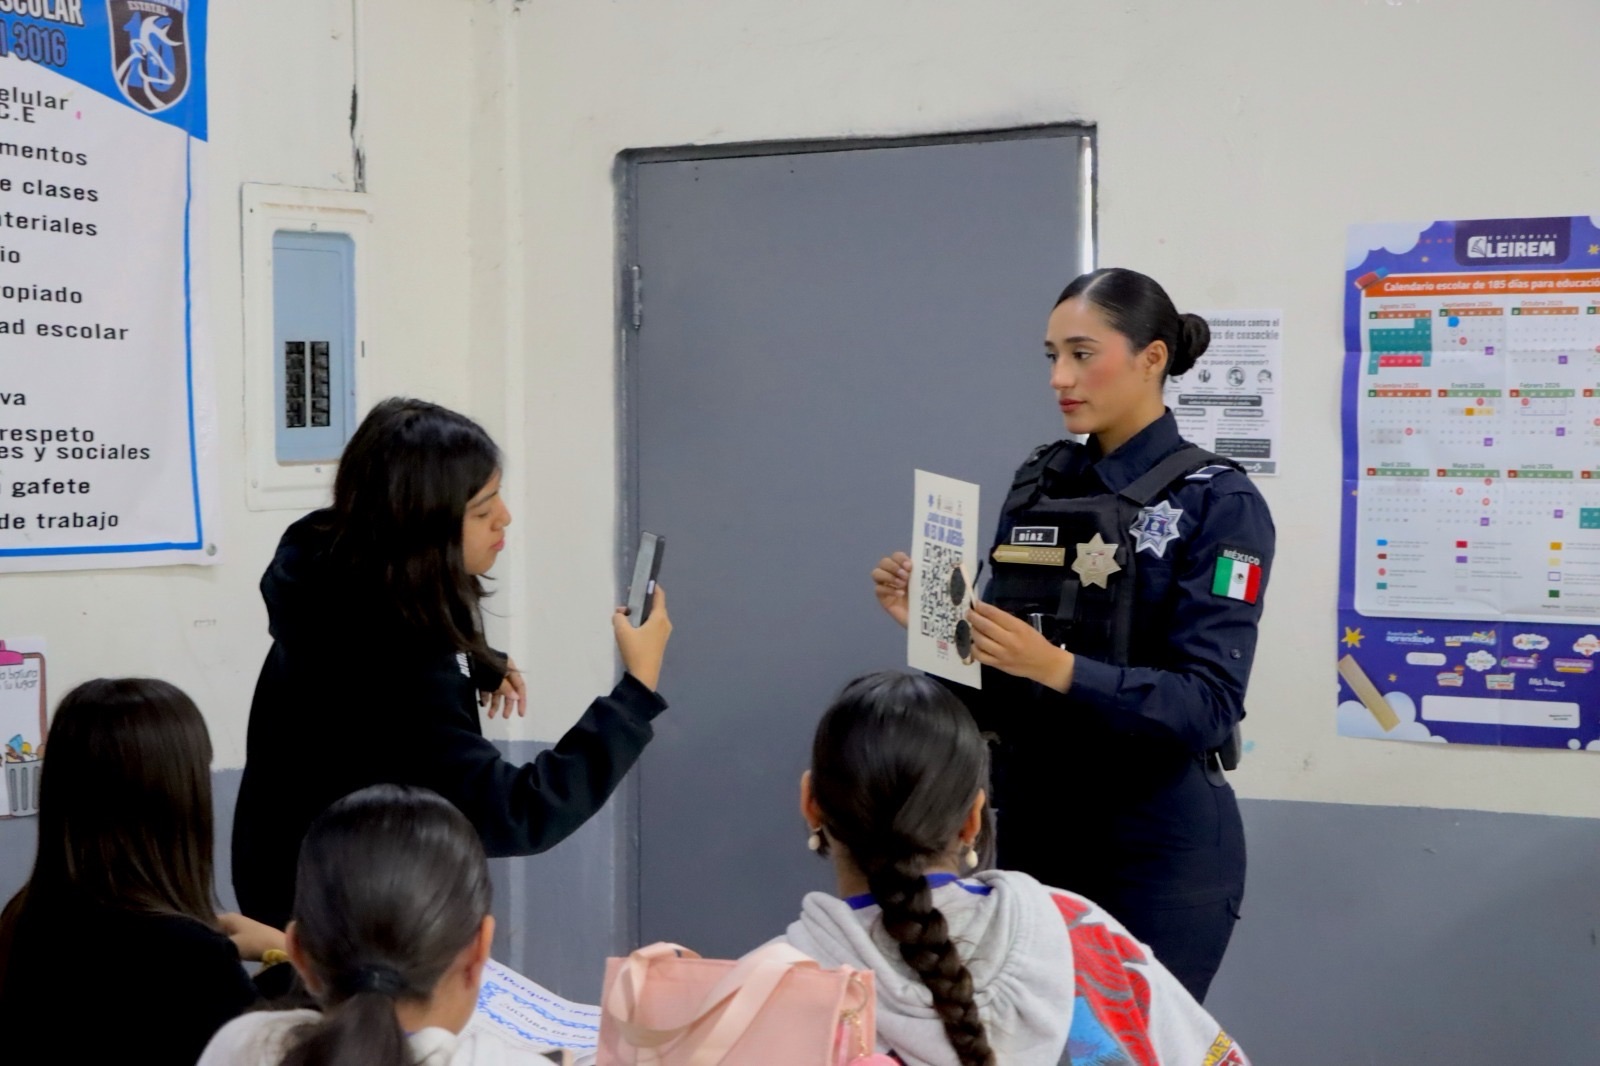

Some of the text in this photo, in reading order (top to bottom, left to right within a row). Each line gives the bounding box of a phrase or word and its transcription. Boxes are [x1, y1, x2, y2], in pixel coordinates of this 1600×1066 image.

[13, 21, 67, 67] 3016
[0, 87, 69, 110] elular
[0, 142, 88, 166] mentos
[23, 179, 99, 202] clases
[0, 212, 98, 236] teriales
[1486, 241, 1556, 258] LEIREM
[0, 284, 83, 303] opiado
[1384, 281, 1434, 292] Calendario
[1436, 281, 1471, 290] escolar
[1473, 280, 1485, 289] de
[1488, 280, 1506, 289] 185
[1531, 280, 1554, 291] para
[37, 323, 129, 340] escolar
[0, 427, 95, 445] respeto
[34, 446, 46, 462] y
[57, 444, 151, 460] sociales
[11, 478, 90, 498] gafete
[36, 512, 119, 530] trabajo
[1019, 530, 1043, 541] DÍAZ
[1223, 549, 1260, 566] MÉXICO
